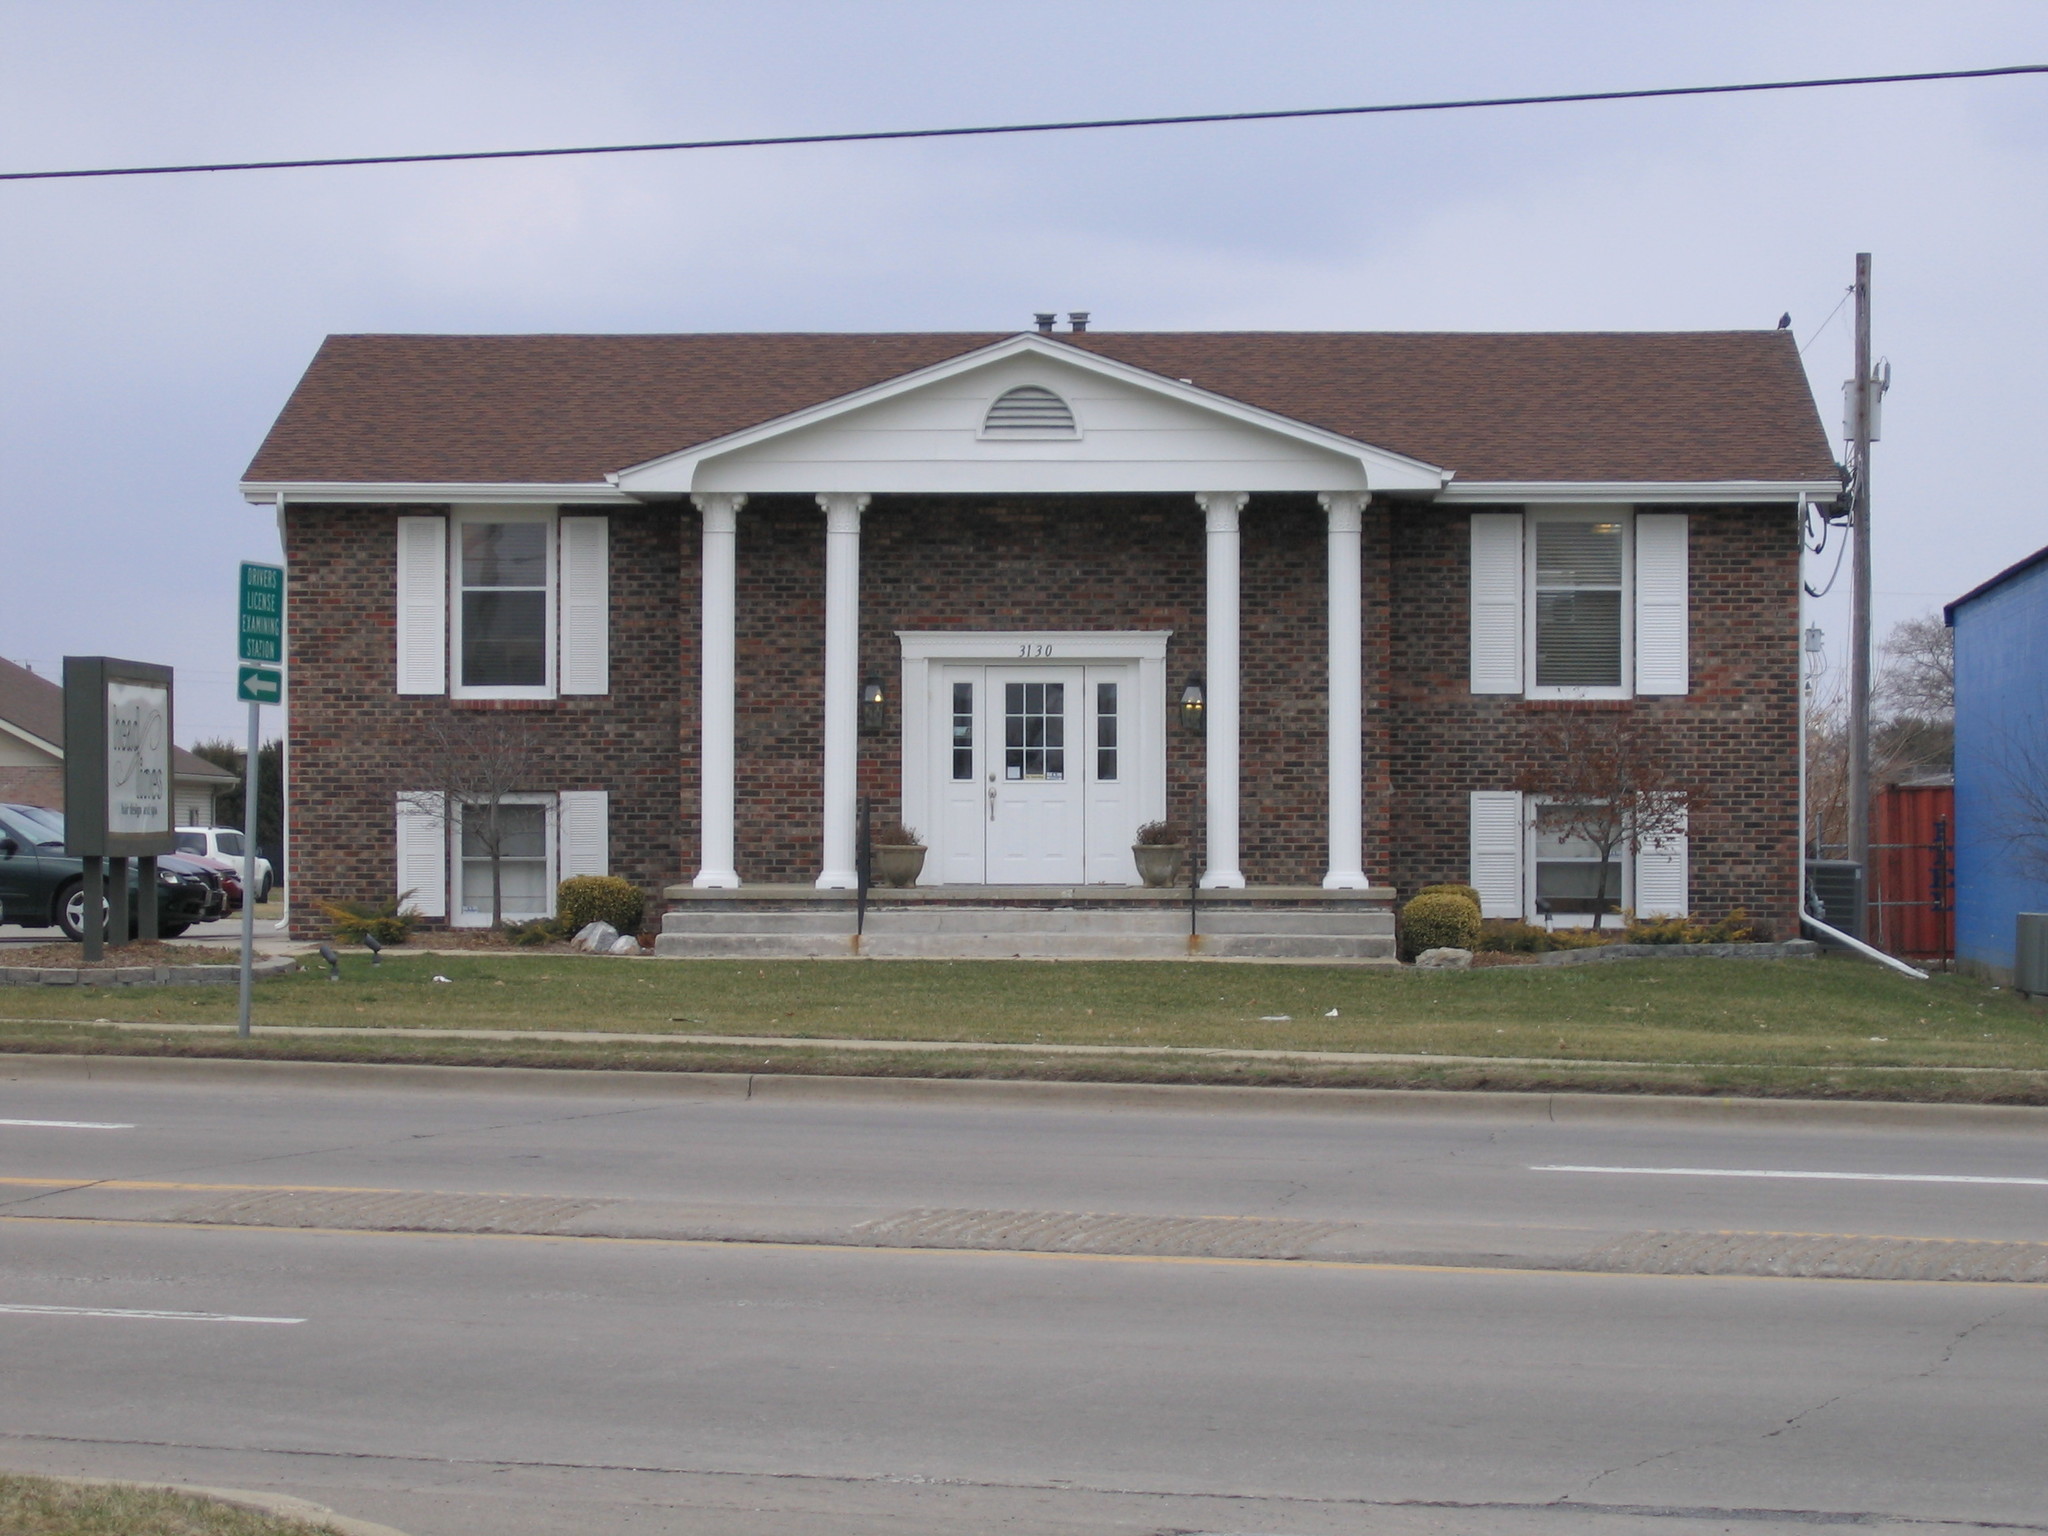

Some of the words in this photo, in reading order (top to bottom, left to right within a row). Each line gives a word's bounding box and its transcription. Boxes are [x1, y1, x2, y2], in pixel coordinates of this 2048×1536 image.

[247, 567, 277, 589] DRIVERS
[247, 591, 275, 613] LICENSE
[242, 614, 279, 636] EXAMINING
[246, 638, 275, 659] STATION
[1019, 644, 1053, 658] 3130
